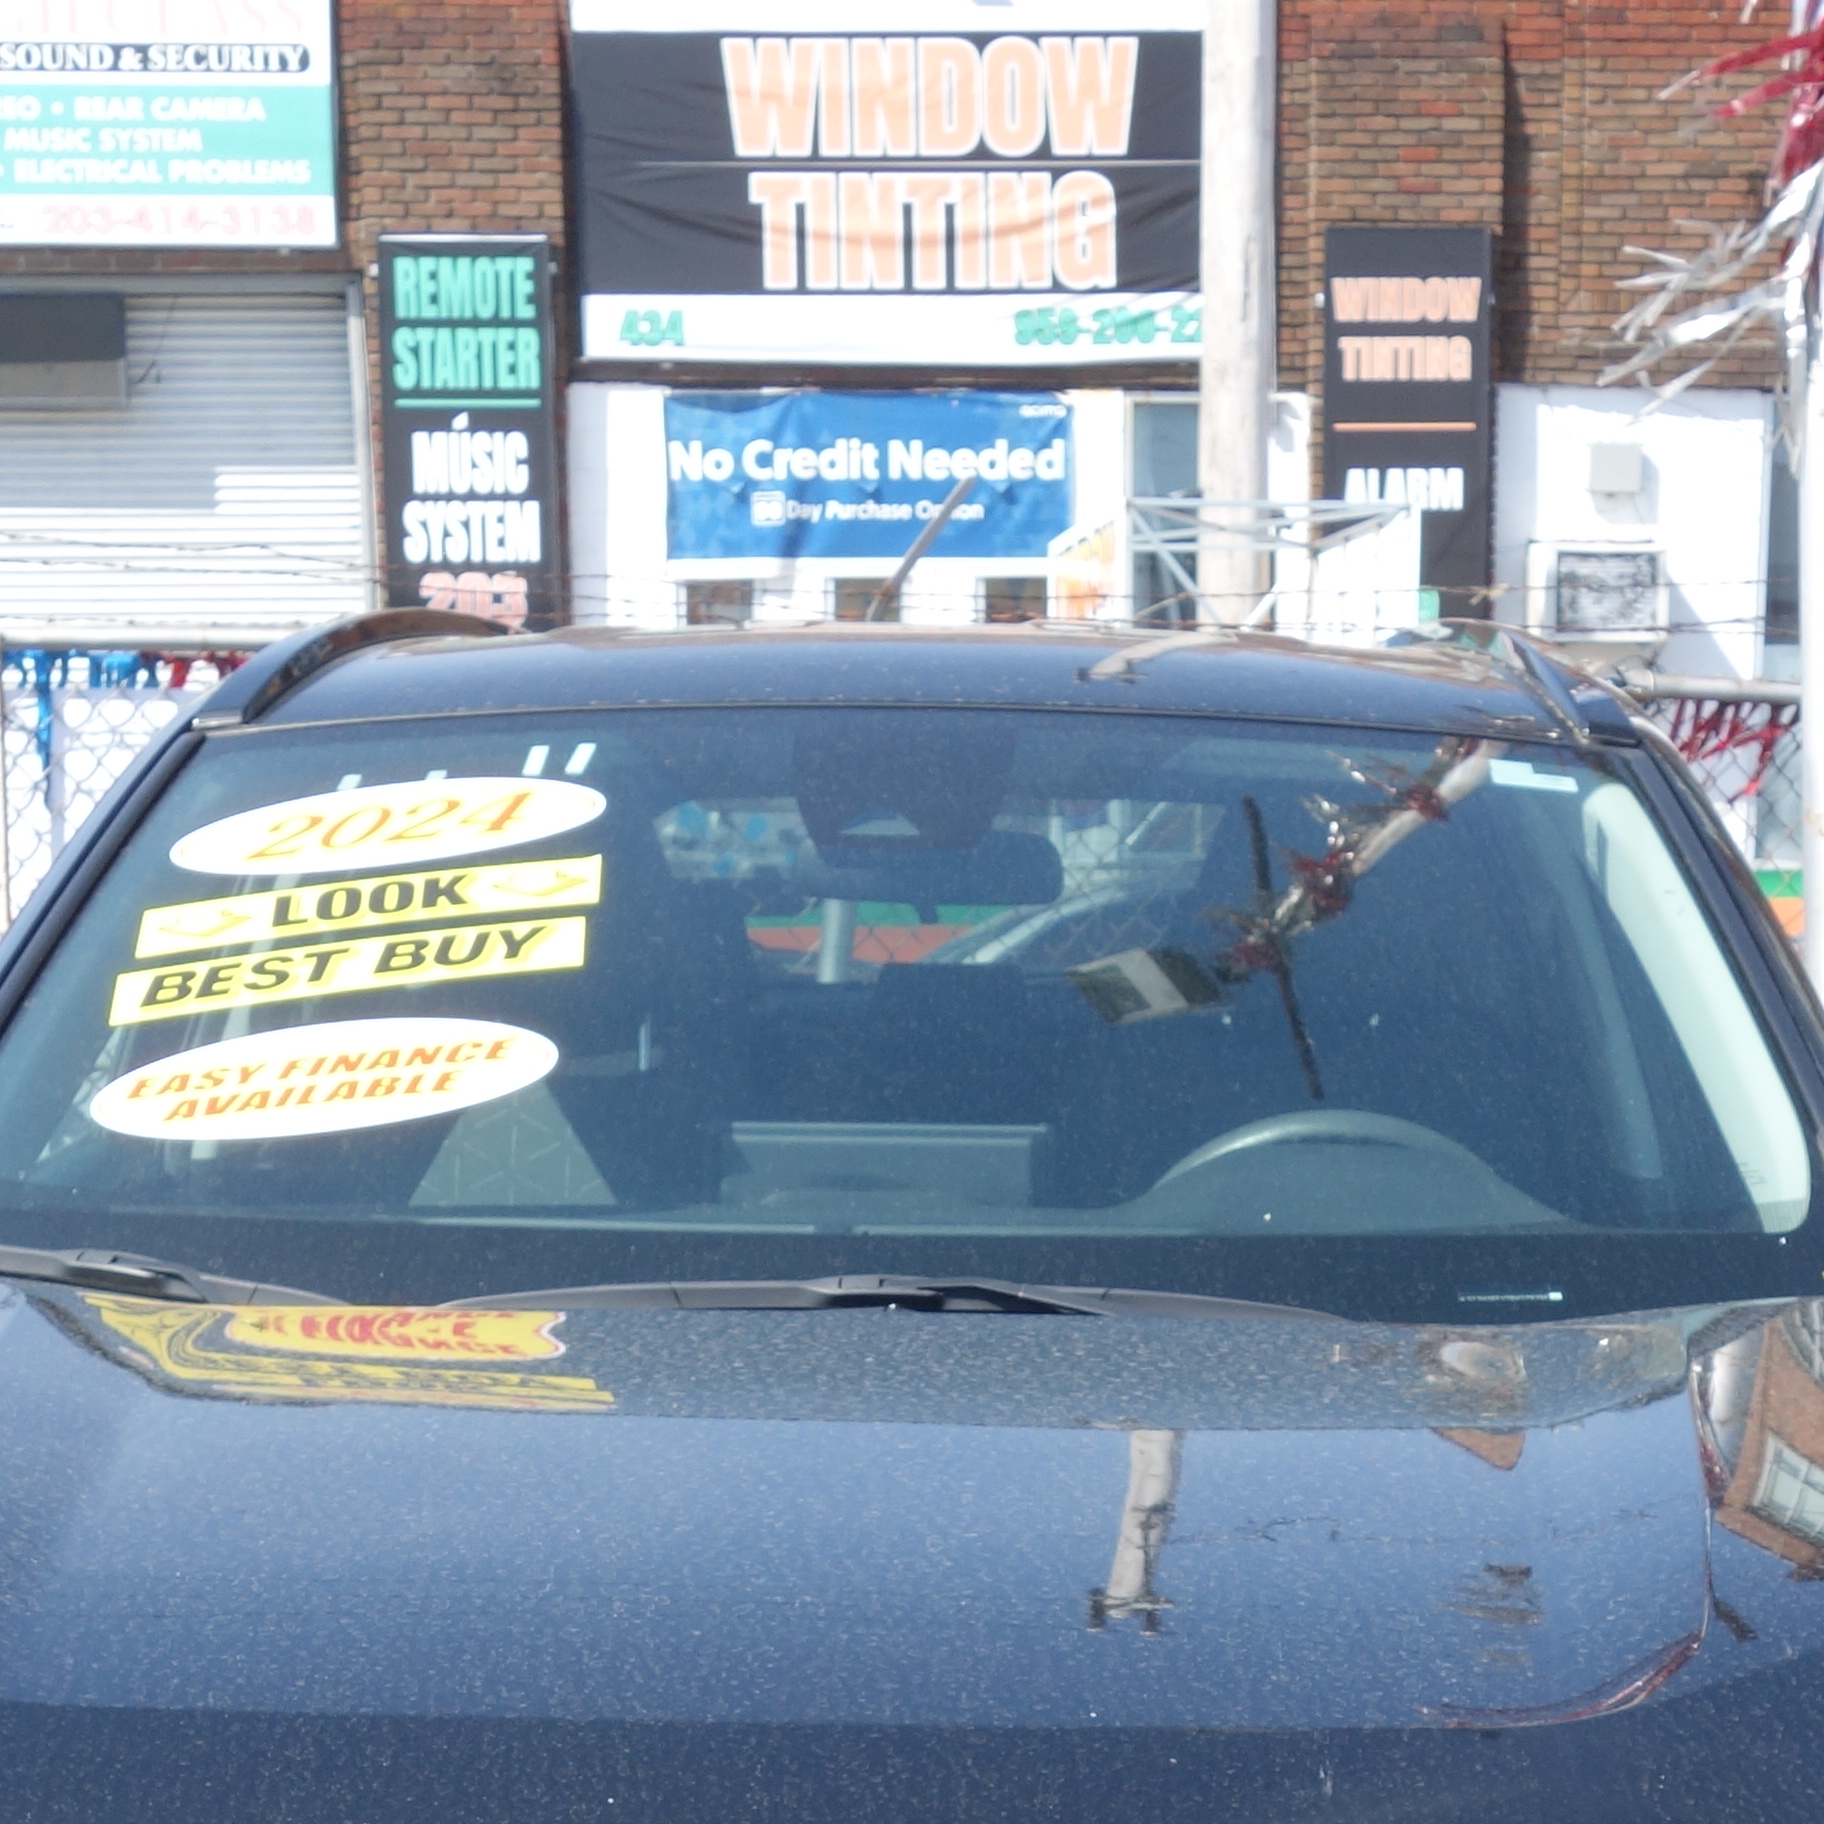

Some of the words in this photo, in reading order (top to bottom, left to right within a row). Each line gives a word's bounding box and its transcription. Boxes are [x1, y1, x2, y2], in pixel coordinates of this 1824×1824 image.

[118, 47, 143, 71] &
[147, 44, 305, 72] SECURITY
[72, 96, 145, 121] REAR
[150, 96, 267, 122] CAMERA
[720, 36, 1139, 157] WINDOW
[4, 127, 92, 152] MUSIC
[98, 127, 203, 152] SYSTEM
[13, 158, 163, 183] ELECTRICAL
[168, 159, 312, 184] PROBLEMS
[748, 170, 1117, 290] TINTING
[392, 256, 536, 320] REMOTE
[1331, 276, 1482, 323] WINDOW
[619, 309, 685, 346] 434
[392, 326, 541, 389] STARTER
[1337, 336, 1473, 382] TINTING
[668, 440, 734, 481] No
[742, 438, 880, 481] Credit
[888, 439, 1066, 480] Needed
[402, 500, 541, 563] SYSTEM
[787, 500, 822, 523] Day
[825, 498, 912, 521] Purchase
[246, 791, 533, 862] 2024
[272, 873, 469, 928] LOOK
[140, 947, 351, 1008] BEST
[373, 926, 550, 975] BUY
[127, 1063, 267, 1100] EASY
[277, 1038, 518, 1081] FINANCE
[163, 1069, 466, 1122] AVAILABLE
